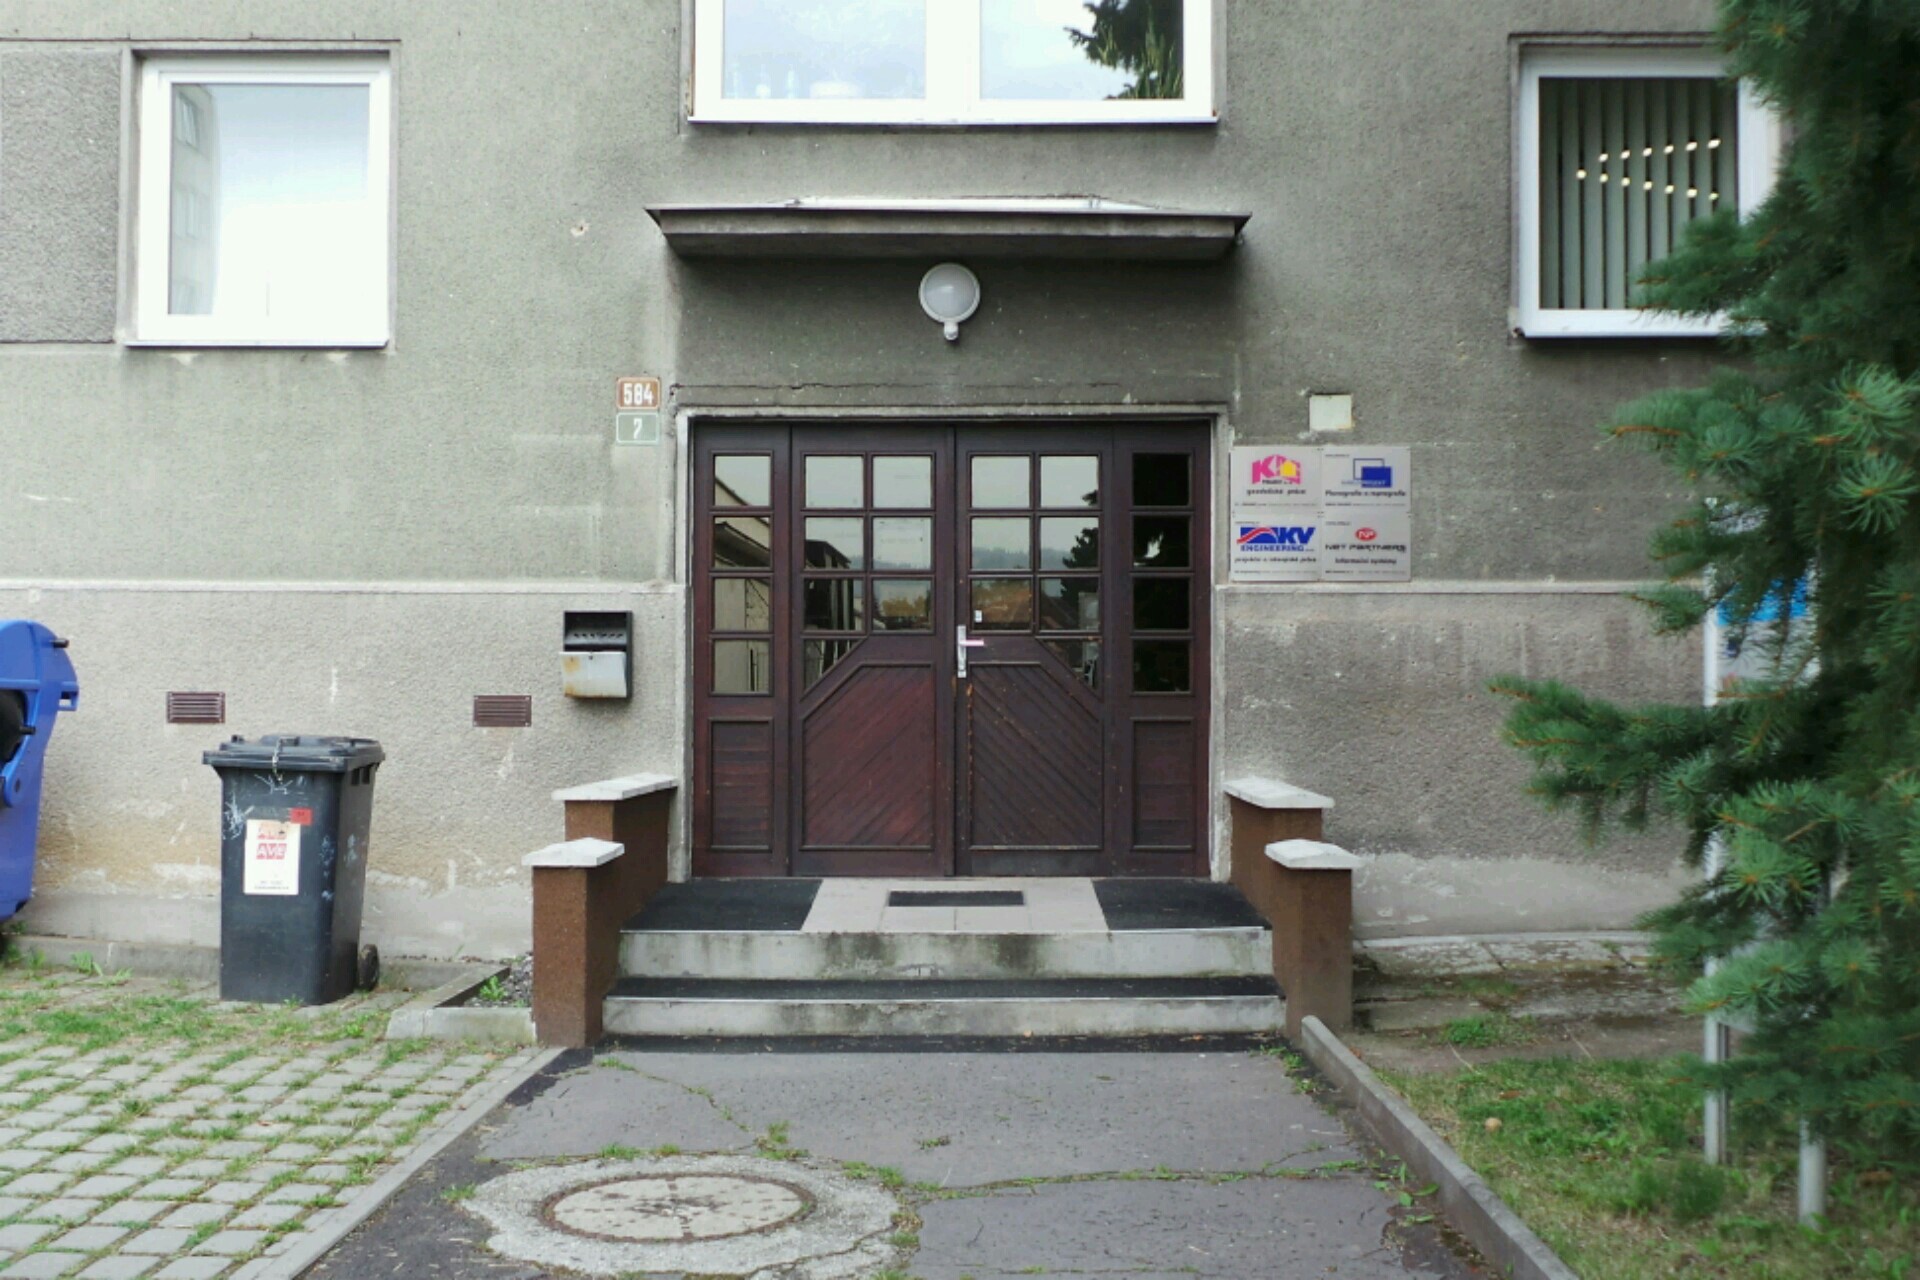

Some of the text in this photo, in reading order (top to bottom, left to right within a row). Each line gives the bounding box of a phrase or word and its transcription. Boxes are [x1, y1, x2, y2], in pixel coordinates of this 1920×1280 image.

[623, 382, 653, 405] 584
[633, 418, 642, 440] 7
[1278, 526, 1317, 545] KV
[257, 842, 287, 860] AVE
